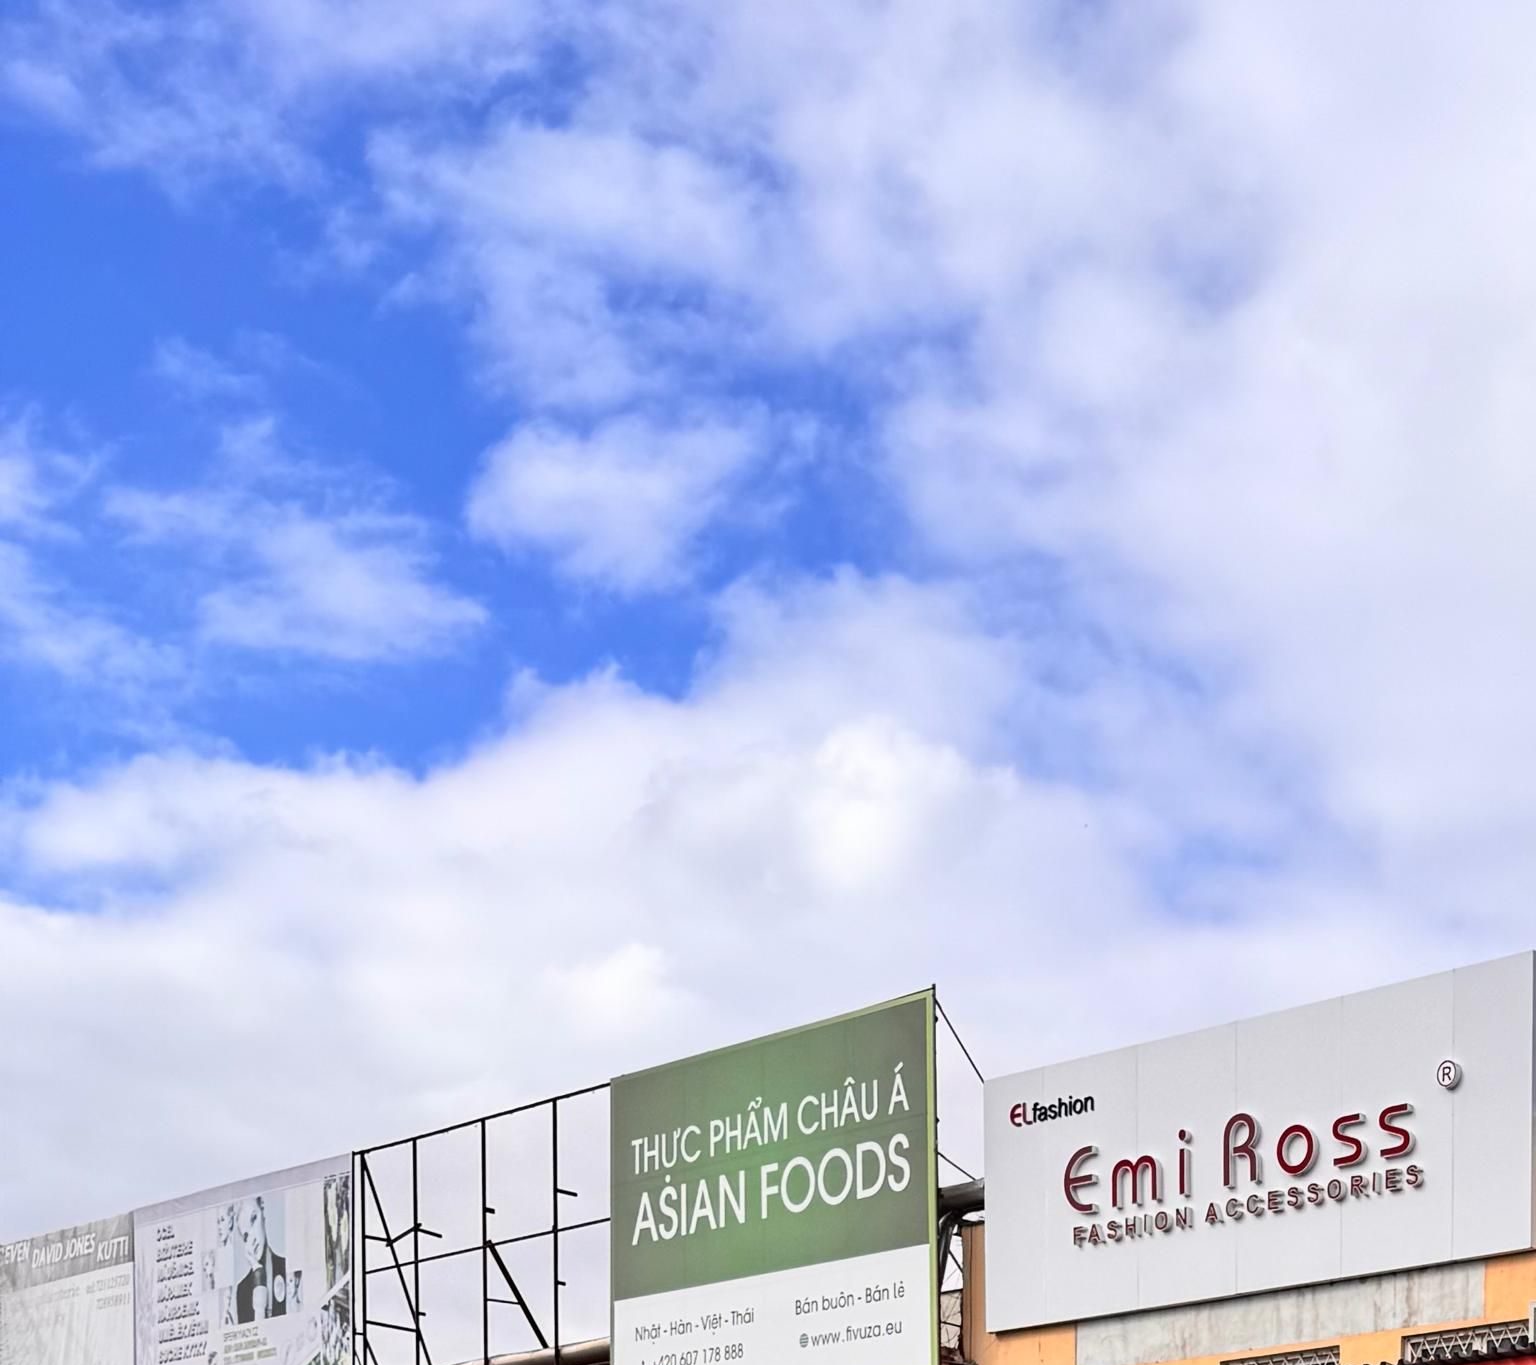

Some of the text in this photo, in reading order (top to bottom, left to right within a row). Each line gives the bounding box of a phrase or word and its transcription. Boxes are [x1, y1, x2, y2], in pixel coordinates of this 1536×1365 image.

[631, 1061, 910, 1183] THỰC PHẨM CHÂU Á
[1063, 1129, 1193, 1214] Emi
[1222, 1102, 1415, 1189] Ross
[631, 1133, 911, 1246] ASIAN FOODS
[1072, 1164, 1425, 1248] FASHION ACCESSORIES
[31, 1242, 63, 1268] DAVID
[64, 1233, 96, 1260] JONES
[97, 1236, 129, 1262] KUTTI
[795, 1297, 819, 1315] Bán
[822, 1291, 854, 1310] buôn
[865, 1285, 882, 1304] Bán
[635, 1308, 755, 1345] Nhật Hàn Việt Thái
[811, 1320, 903, 1347] www.fivuza.eu
[701, 1345, 721, 1364] 178
[724, 1343, 744, 1360] 888
